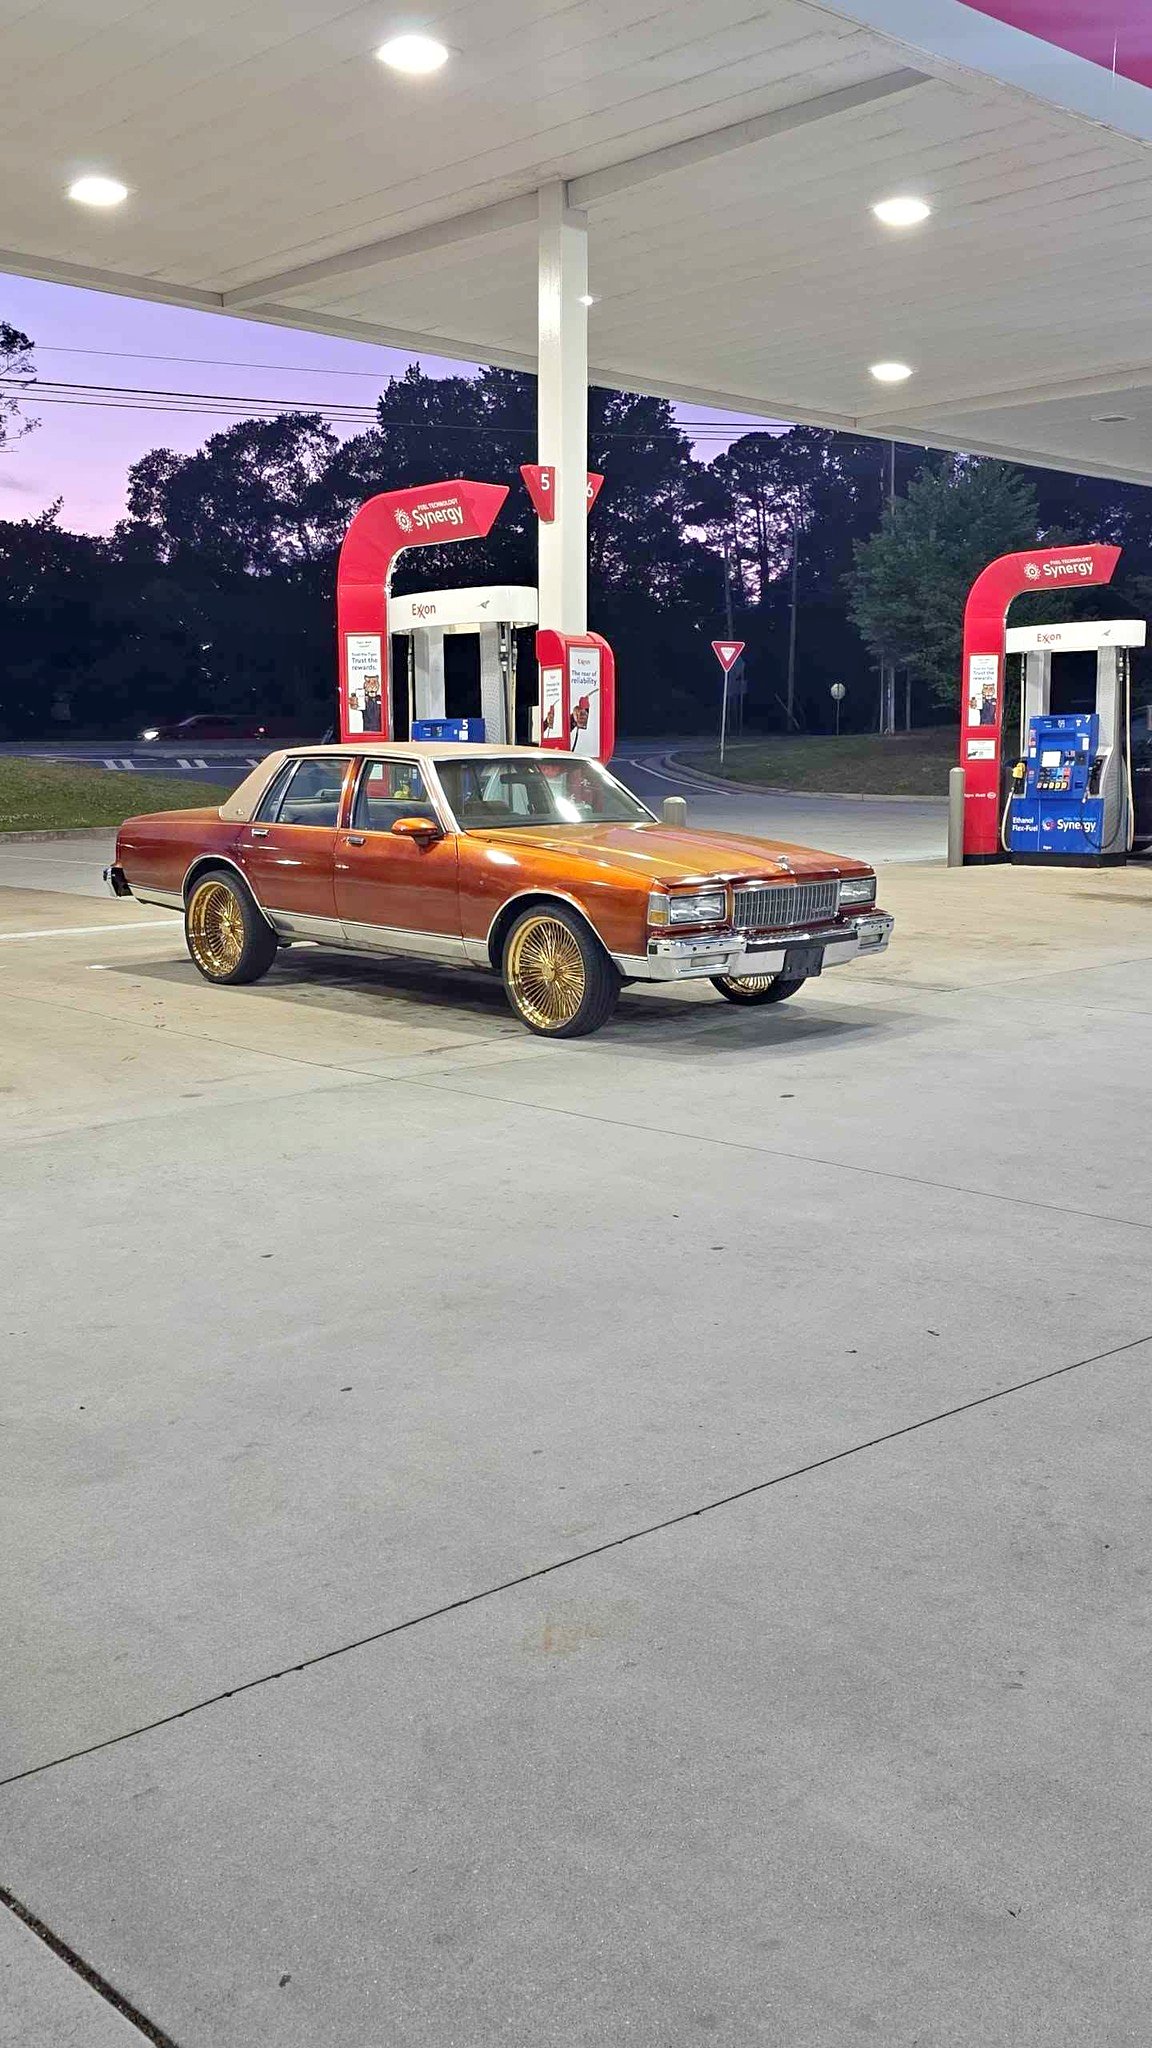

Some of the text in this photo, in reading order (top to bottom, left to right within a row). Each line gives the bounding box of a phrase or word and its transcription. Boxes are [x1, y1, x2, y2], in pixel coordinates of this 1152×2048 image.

[541, 473, 550, 491] 5
[586, 481, 594, 498] 6
[412, 506, 463, 530] Synergy
[1042, 562, 1094, 578] Synergy
[411, 603, 437, 619] Exxon
[1036, 633, 1062, 644] Exxon
[571, 677, 597, 686] reliability
[462, 719, 469, 730] 5
[1085, 714, 1092, 724] 7
[1012, 816, 1034, 824] Ethanol
